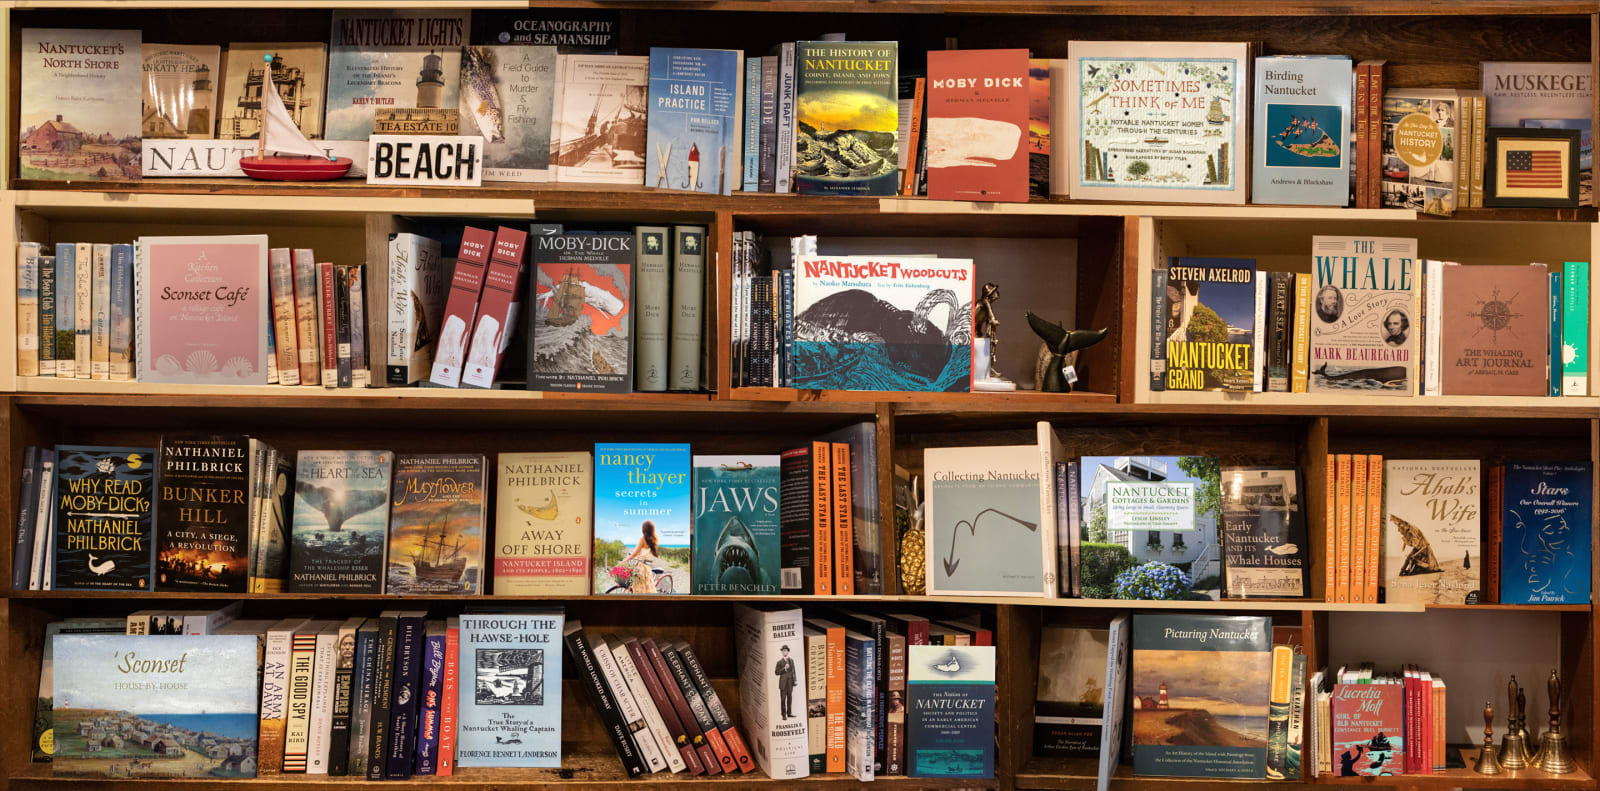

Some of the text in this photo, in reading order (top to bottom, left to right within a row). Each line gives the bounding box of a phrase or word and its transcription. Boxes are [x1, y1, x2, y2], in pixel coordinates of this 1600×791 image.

[340, 18, 463, 46] NANTUCKET LIGHTS
[514, 20, 612, 32] OCEANOGRAPHY
[514, 34, 611, 45] and SEAMANSHIP
[39, 42, 124, 55] NANTUCKET'S
[806, 49, 891, 58] THE HISTORY OF
[43, 58, 120, 69] NORTH SHORE
[525, 64, 549, 72] Guide
[805, 59, 892, 71] NANTUCKET
[522, 74, 530, 82] to
[934, 78, 1023, 88] MOBY DICK
[1265, 70, 1303, 84] Birding
[510, 84, 538, 92] Murder
[670, 84, 705, 96] ISLAND
[784, 72, 792, 100] JUNK
[1113, 80, 1200, 92] SOMETIMES
[1265, 84, 1317, 96] Nantucket
[658, 97, 705, 110] PRACTICE
[1110, 96, 1160, 109] THINK
[1182, 97, 1205, 109] ME
[517, 105, 529, 114] Fly
[783, 102, 791, 128] RAFT
[508, 115, 536, 126] Fishing
[375, 142, 476, 180] BEACH
[538, 237, 631, 250] MOBY-DICK
[1354, 241, 1375, 254] THE
[804, 260, 968, 281] NANTUCKET WOODCUTS
[1170, 267, 1251, 283] STEVEN AXELROD
[1315, 256, 1412, 290] WHALE
[160, 286, 250, 307] Sconset Café
[1341, 299, 1388, 328] A Love Story
[1169, 341, 1250, 370] NANTUCKET
[1315, 347, 1409, 361] MARK BEAUREGARD
[1484, 350, 1524, 358] WHALING
[1456, 358, 1534, 368] ART JOURNAL
[1169, 370, 1204, 389] GRAND
[165, 447, 245, 458] NATHANIEL
[167, 461, 243, 472] PHILBRICK
[600, 452, 655, 471] nancy
[505, 464, 584, 474] NATHANIEL
[508, 476, 581, 486] PHILBRICK
[628, 467, 687, 490] thayer
[934, 470, 1039, 482] Collecting Nantucket
[68, 478, 142, 494] WHY READ
[1400, 472, 1477, 497] Ahab's
[1531, 482, 1570, 496] Stars
[164, 487, 246, 504] BUNKER
[615, 490, 658, 498] secrets
[1112, 487, 1190, 497] NANTUCKET
[61, 495, 150, 512] MOBY-DICK?
[697, 486, 778, 518] JAWS
[180, 508, 227, 524] HILL
[624, 507, 672, 516] summer
[1426, 499, 1477, 526] Wife
[68, 519, 142, 535] NATHANIEL
[1225, 521, 1251, 532] Early
[209, 534, 238, 542] SIEGE,
[521, 530, 564, 540] AWAY
[1226, 533, 1279, 543] Nantucket
[68, 536, 141, 551] PHILBRICK
[178, 543, 235, 552] REVOLUTION
[502, 544, 582, 555] OFF SHORE
[1227, 555, 1302, 566] Whale Houses
[729, 584, 777, 592] BENCHLEY
[1528, 594, 1540, 602] Jim
[463, 619, 556, 630] THROUGH THE
[470, 633, 550, 643] HAWSE-HOLE
[1164, 628, 1259, 642] Picturing Nantucket
[114, 651, 188, 674] 'Sconset
[292, 656, 310, 720] THE GOOD SPY
[1336, 686, 1381, 699] Lucretia
[1356, 700, 1383, 716] Mott
